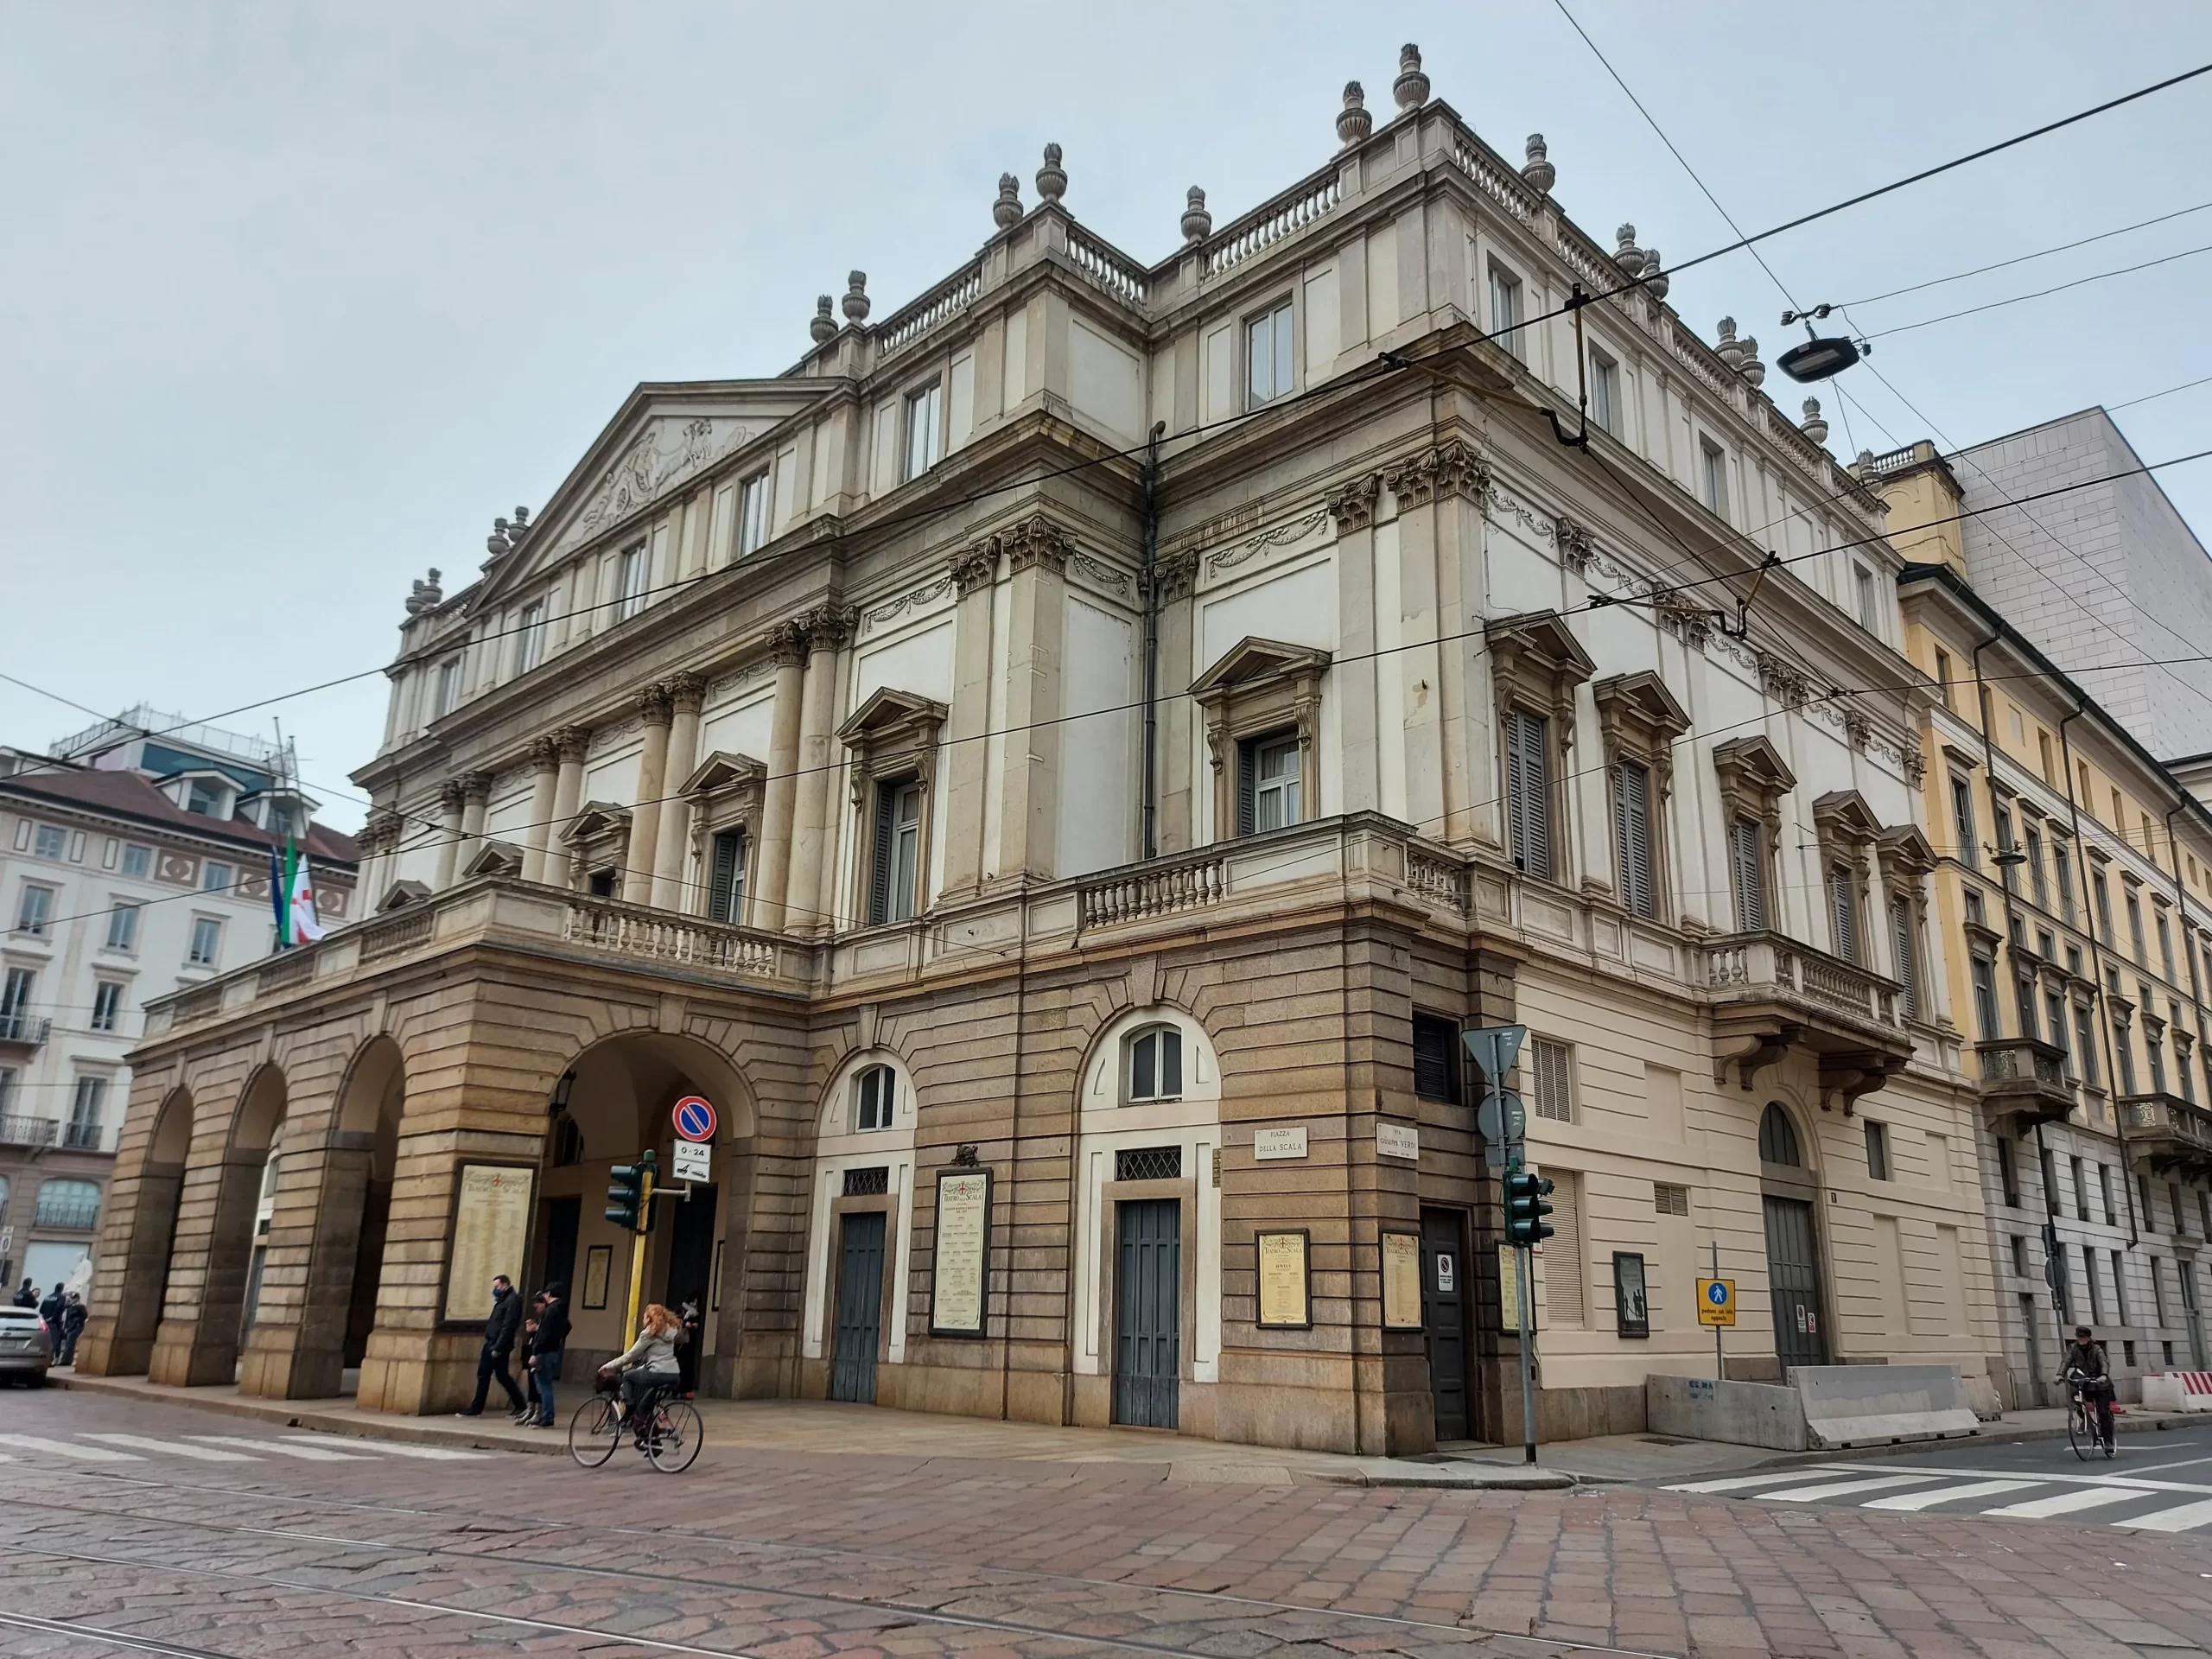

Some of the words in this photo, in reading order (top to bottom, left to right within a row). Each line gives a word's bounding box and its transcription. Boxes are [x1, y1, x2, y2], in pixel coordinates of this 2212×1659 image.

[1280, 1142, 1302, 1151] SCALA
[1379, 1137, 1398, 1147] GIUSEPPE
[1400, 1140, 1416, 1149] VERDI
[965, 1192, 982, 1201] SCALA
